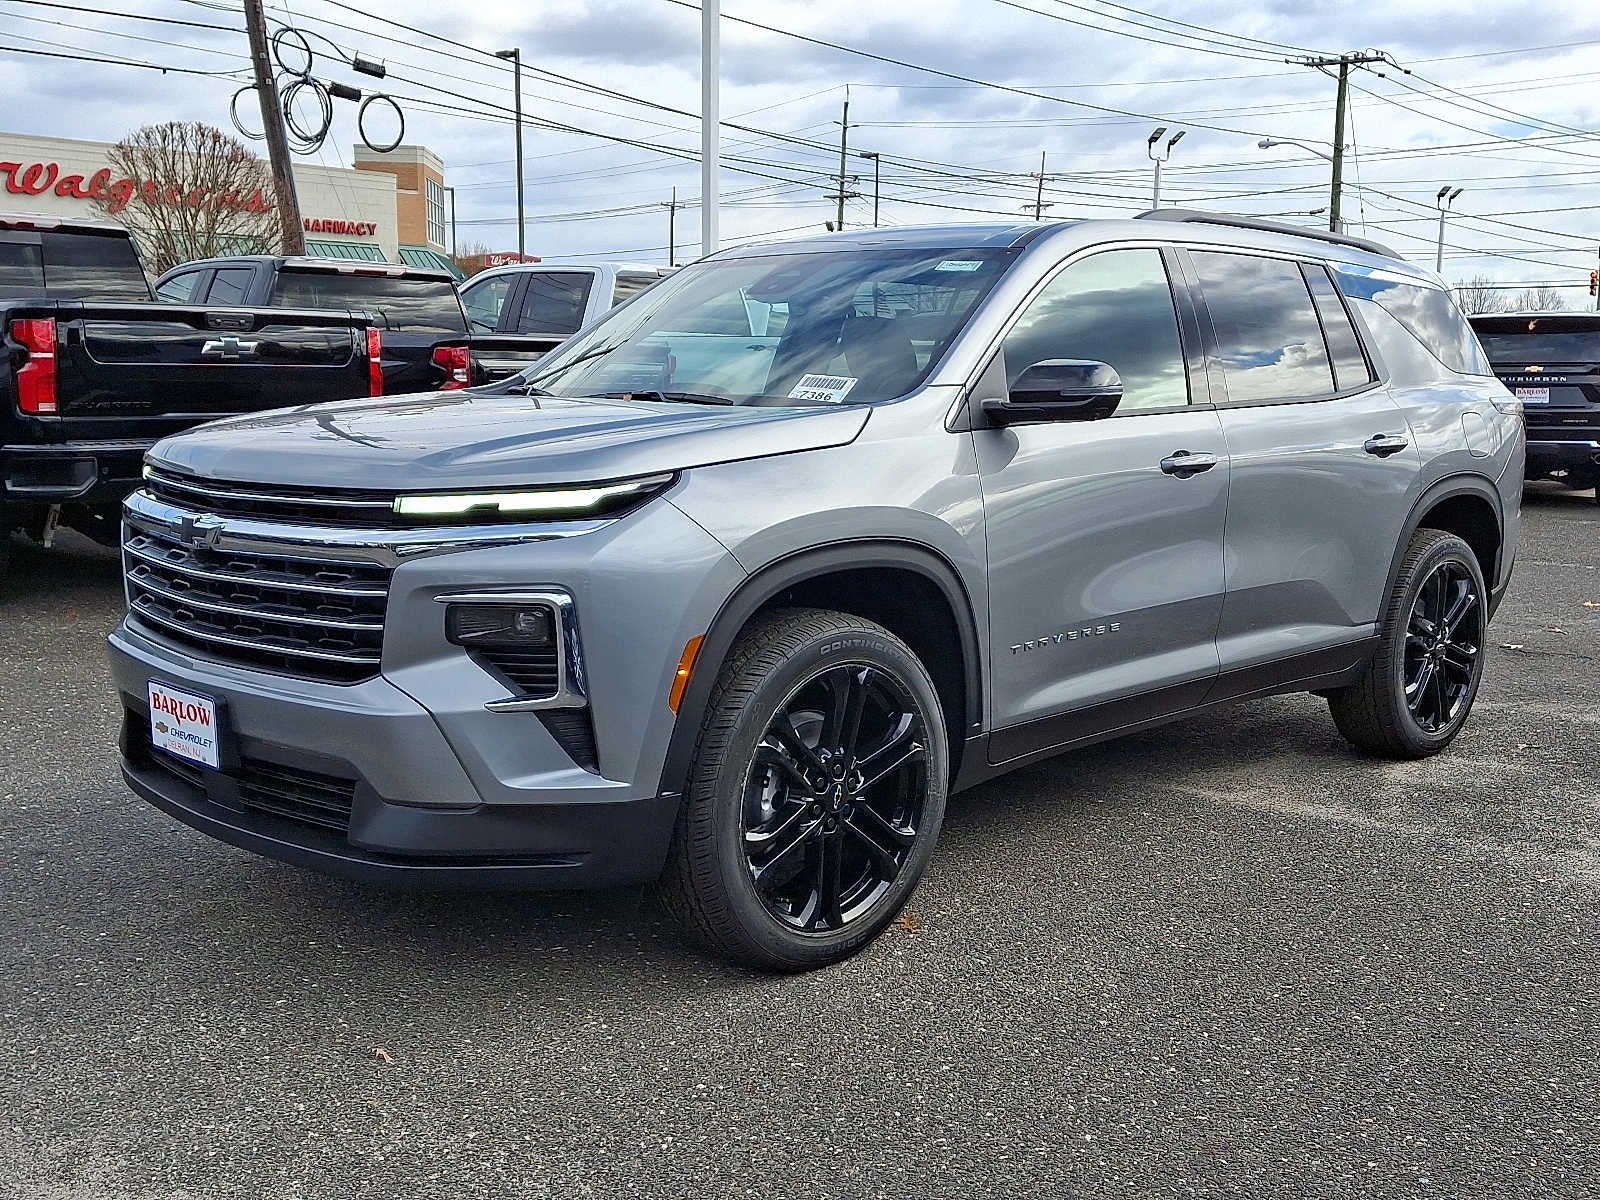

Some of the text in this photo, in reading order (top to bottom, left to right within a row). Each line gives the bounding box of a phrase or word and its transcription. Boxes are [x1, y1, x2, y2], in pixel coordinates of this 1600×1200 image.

[303, 218, 377, 236] HARMACY
[800, 390, 833, 400] 7386
[1517, 388, 1548, 396] BARLOW
[1010, 622, 1121, 654] TRAVERSE
[152, 691, 211, 727] BARLOW
[170, 727, 213, 748] CHEVROLET
